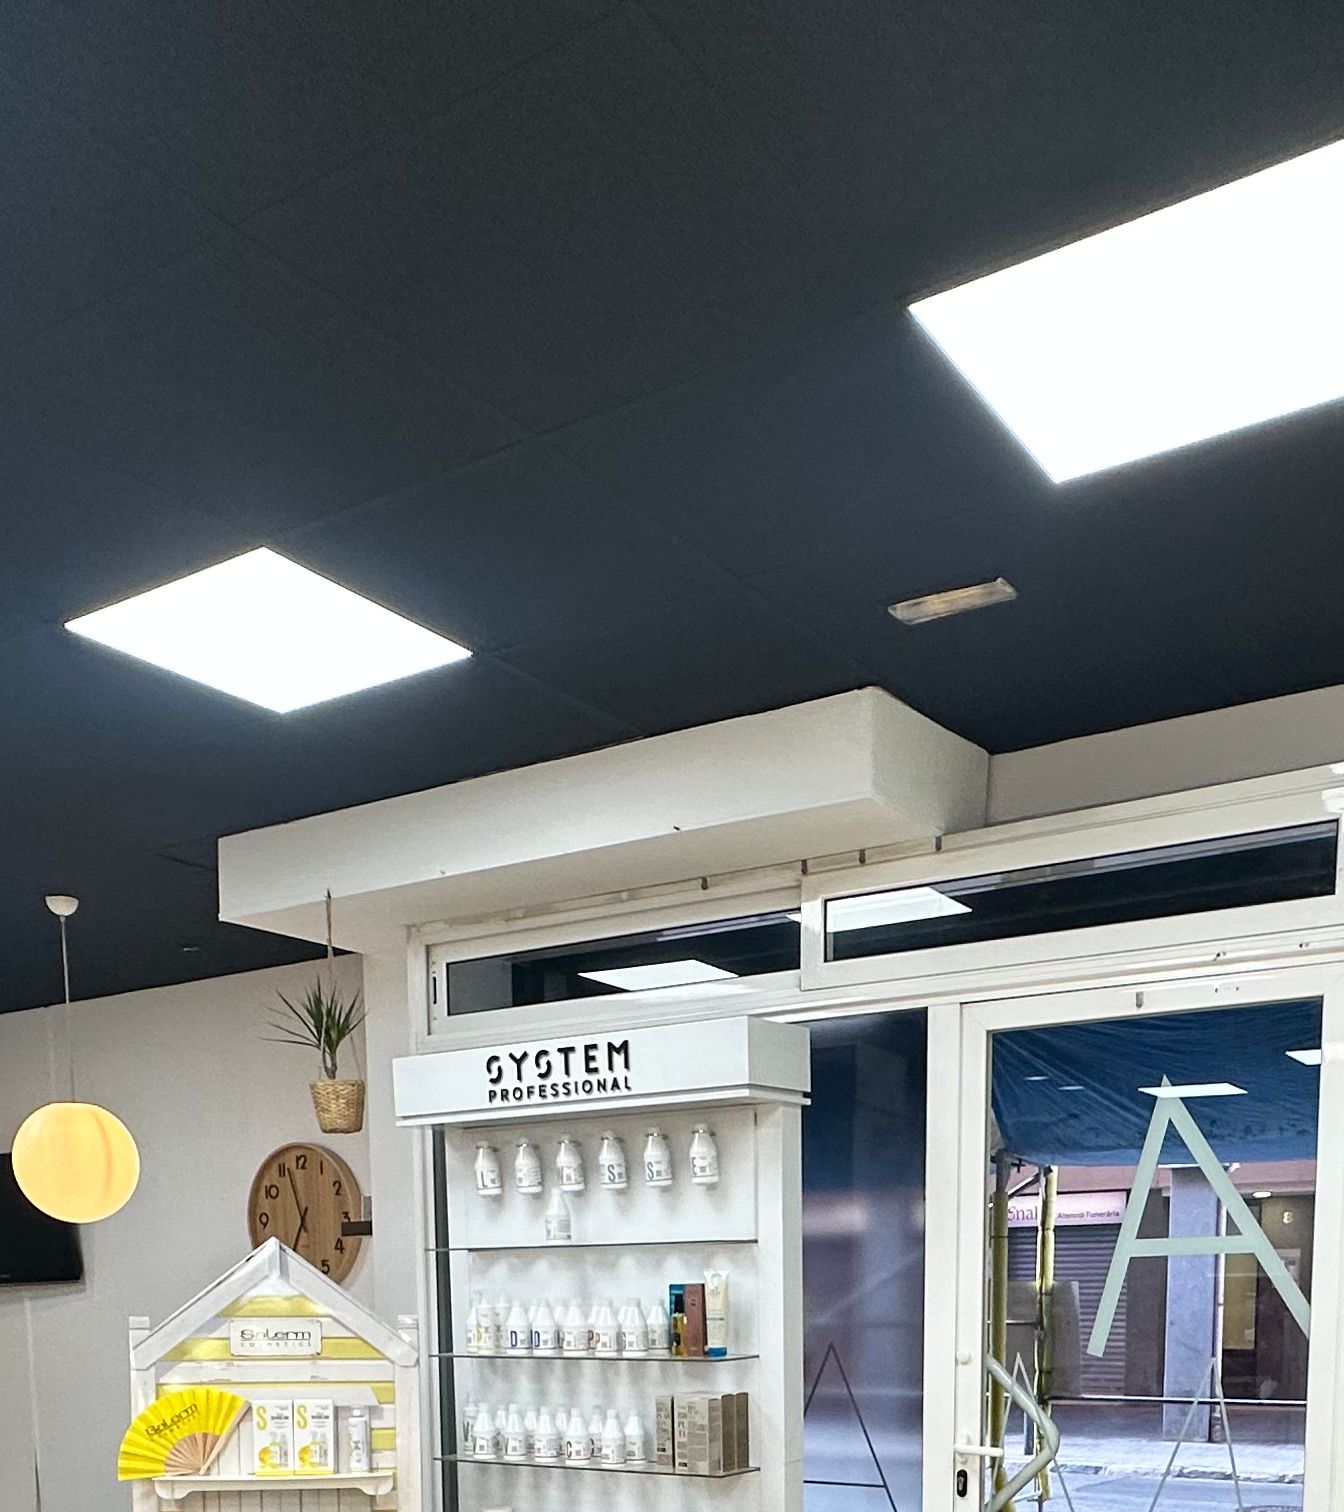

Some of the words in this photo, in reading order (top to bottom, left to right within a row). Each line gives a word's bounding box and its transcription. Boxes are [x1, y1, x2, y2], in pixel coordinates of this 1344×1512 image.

[486, 1039, 631, 1085] SYSTEM
[488, 1075, 632, 1104] PROFESSIONAL
[278, 1162, 286, 1177] 11
[295, 1154, 307, 1170] 12
[264, 1184, 280, 1200] 10
[332, 1180, 342, 1196] 2
[258, 1212, 269, 1230] 9
[334, 1237, 345, 1254] 4
[321, 1259, 331, 1275] 5
[510, 1330, 518, 1348] D
[256, 1405, 267, 1431] S
[296, 1404, 308, 1430] S
